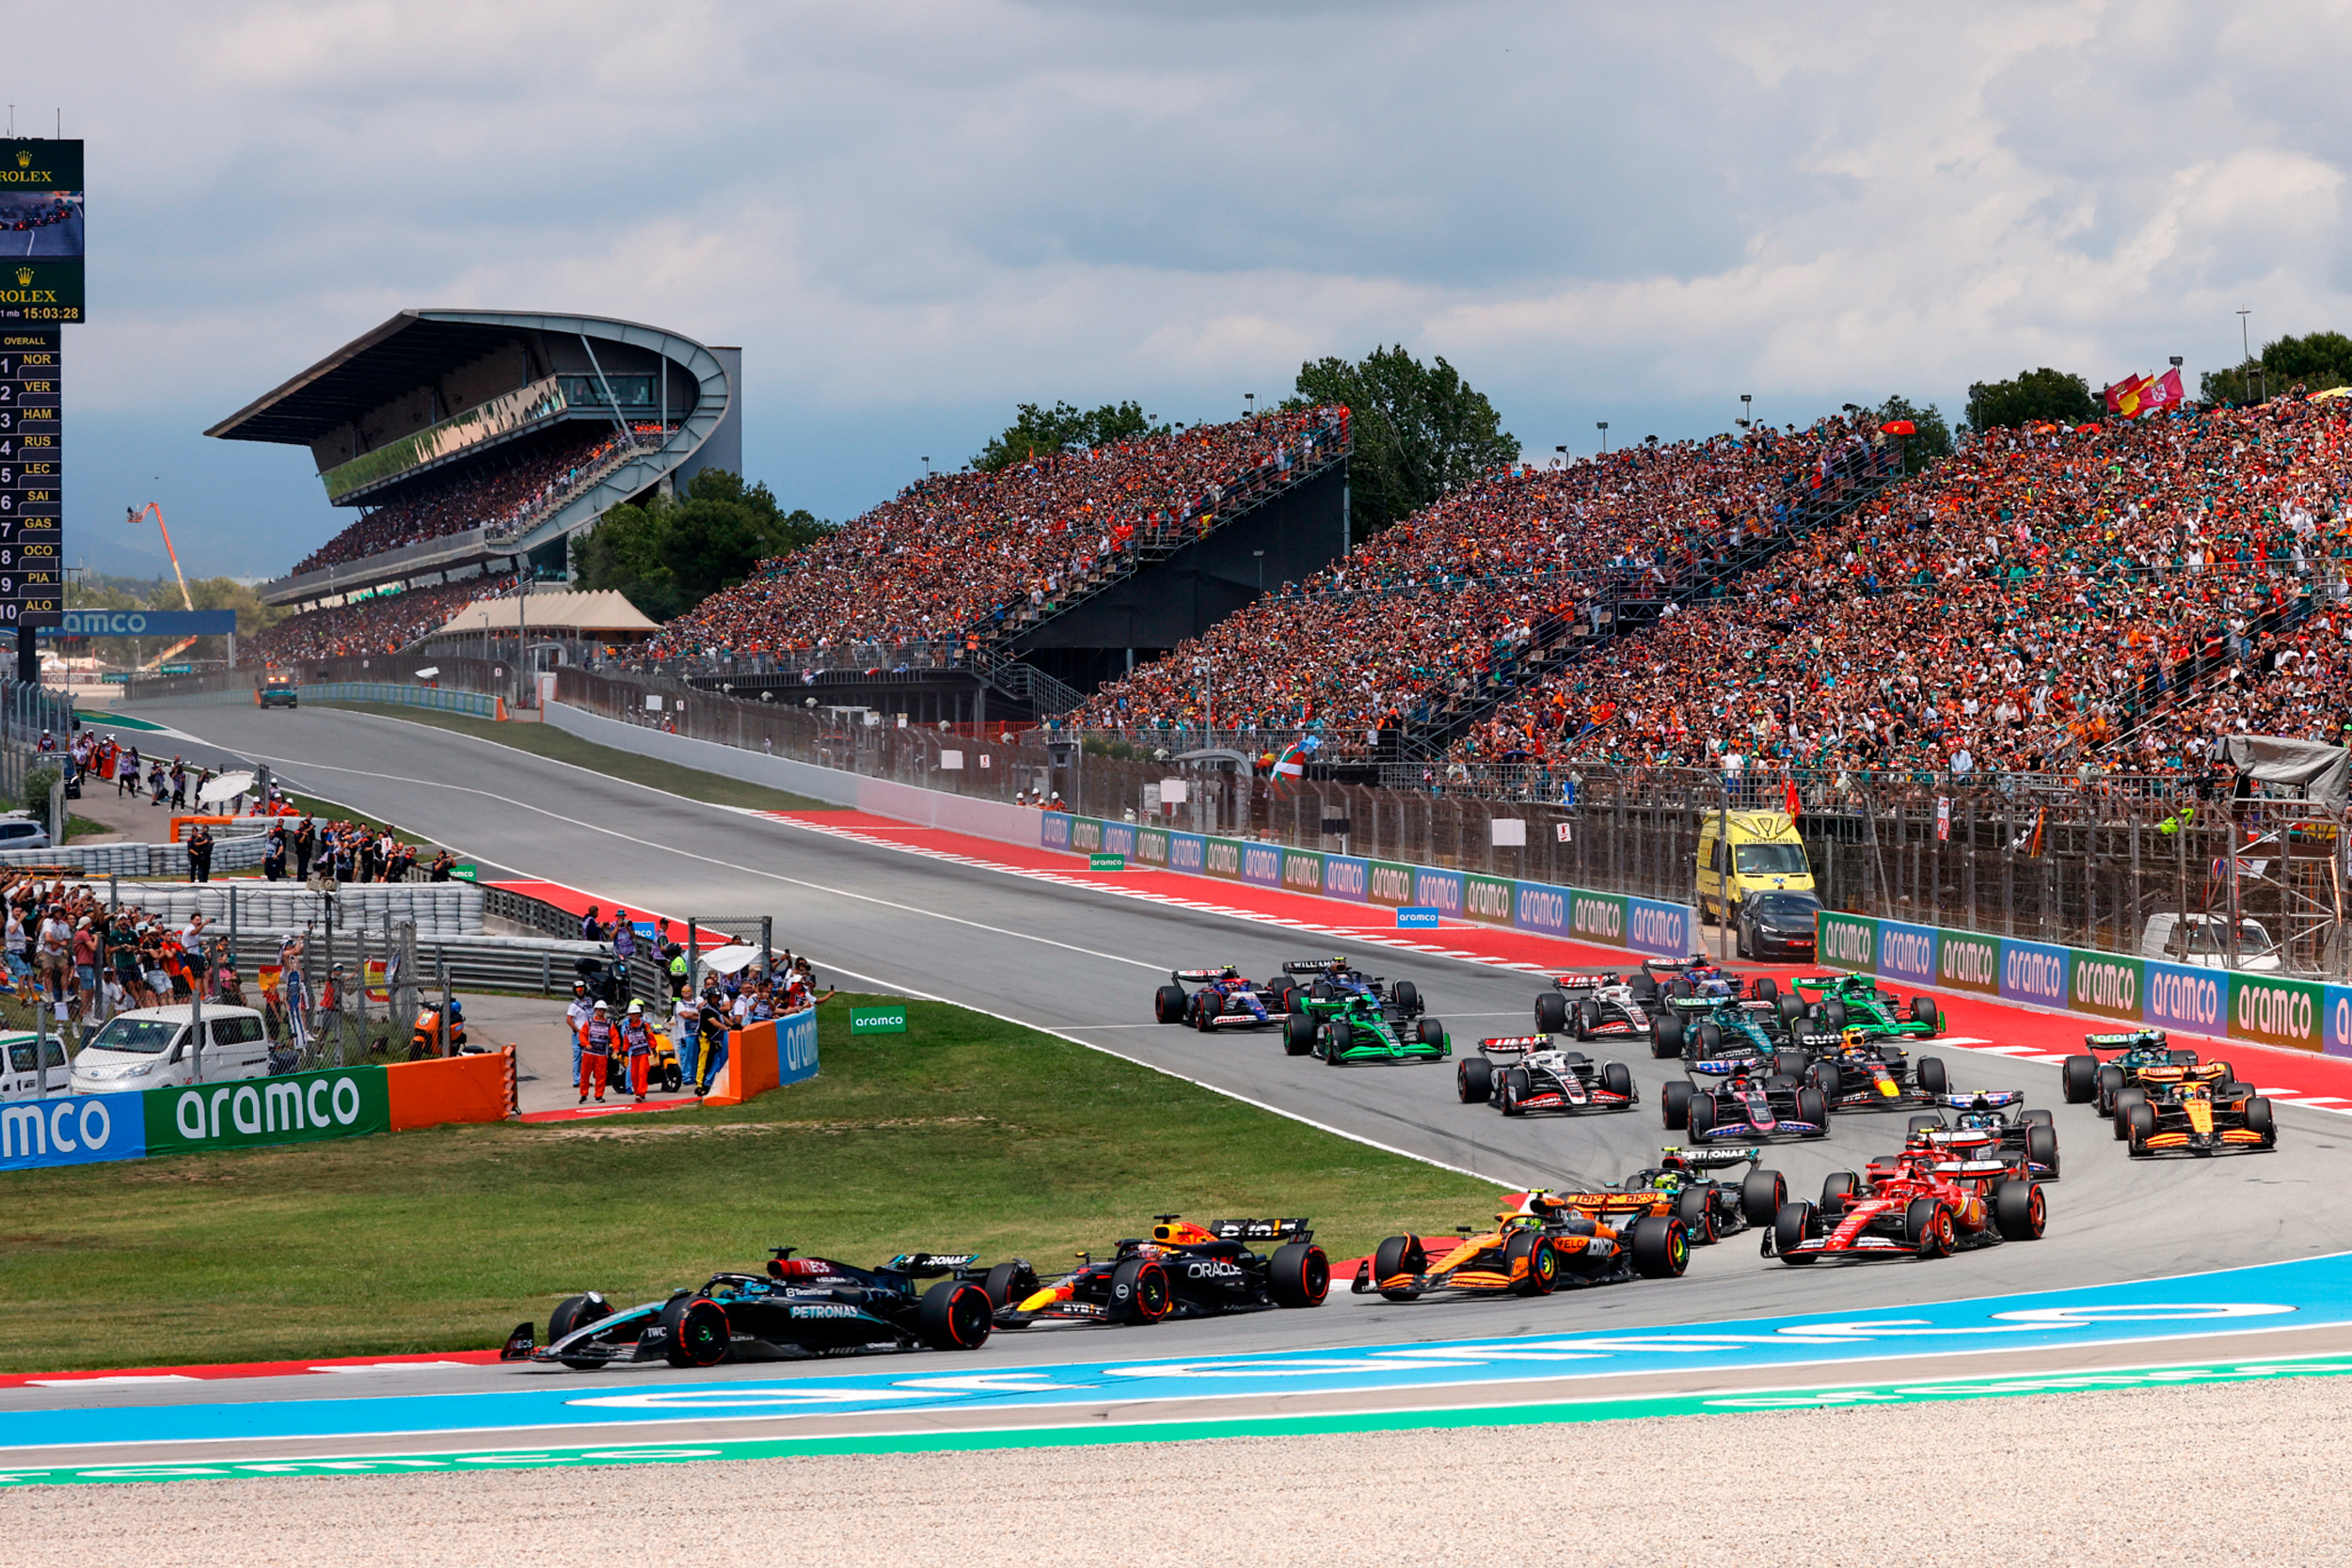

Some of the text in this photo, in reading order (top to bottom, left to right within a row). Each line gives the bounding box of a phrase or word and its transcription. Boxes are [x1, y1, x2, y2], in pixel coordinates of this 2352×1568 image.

[24, 308, 78, 319] 15:03:28
[1, 355, 51, 372] 1 NOR
[0, 382, 50, 400] 2 VER
[0, 409, 52, 427] 3 HAM
[0, 436, 51, 454] 4 RUS
[1, 464, 50, 482] 5 LEC
[1, 491, 49, 509] 6 SAI
[1, 518, 52, 537] 7 GAS
[1, 546, 53, 563] 8 OCO
[1, 573, 49, 592] 9 PIA
[25, 601, 52, 610] ALO
[36, 614, 147, 632] amco
[1044, 817, 1067, 844] aramco
[1073, 822, 1099, 850] aramco
[1105, 827, 1132, 856] aramco
[1138, 832, 1165, 862] aramco
[1172, 838, 1200, 867] aramco
[1208, 843, 1238, 874] aramco
[1246, 848, 1278, 880] aramco
[1286, 855, 1318, 888] aramco
[1327, 861, 1363, 895] aramco
[1373, 867, 1409, 902] aramco
[1420, 875, 1457, 911] aramco
[1468, 880, 1509, 918] aramco
[1520, 889, 1563, 928] aramco
[1575, 897, 1620, 938] aramco
[1633, 906, 1681, 949] aramco
[1825, 920, 1870, 964] aramco
[1883, 930, 1929, 975] aramco
[1943, 940, 1993, 986] aramco
[2007, 949, 2060, 999] aramco
[2076, 959, 2135, 1011] aramco
[2153, 972, 2217, 1025] aramco
[855, 1016, 903, 1026] aramco
[2238, 984, 2312, 1039] aramco
[1715, 1048, 1752, 1058] aramco
[177, 1077, 359, 1139] aramco
[1556, 1238, 1584, 1249] VELO
[801, 1261, 830, 1273] INEOS
[1187, 1262, 1243, 1278] ORACLE
[790, 1306, 858, 1318] PETRONAS
[510, 1338, 532, 1349] INEOS
[647, 1326, 667, 1338] IWC
[562, 1303, 2300, 1408] aramco
